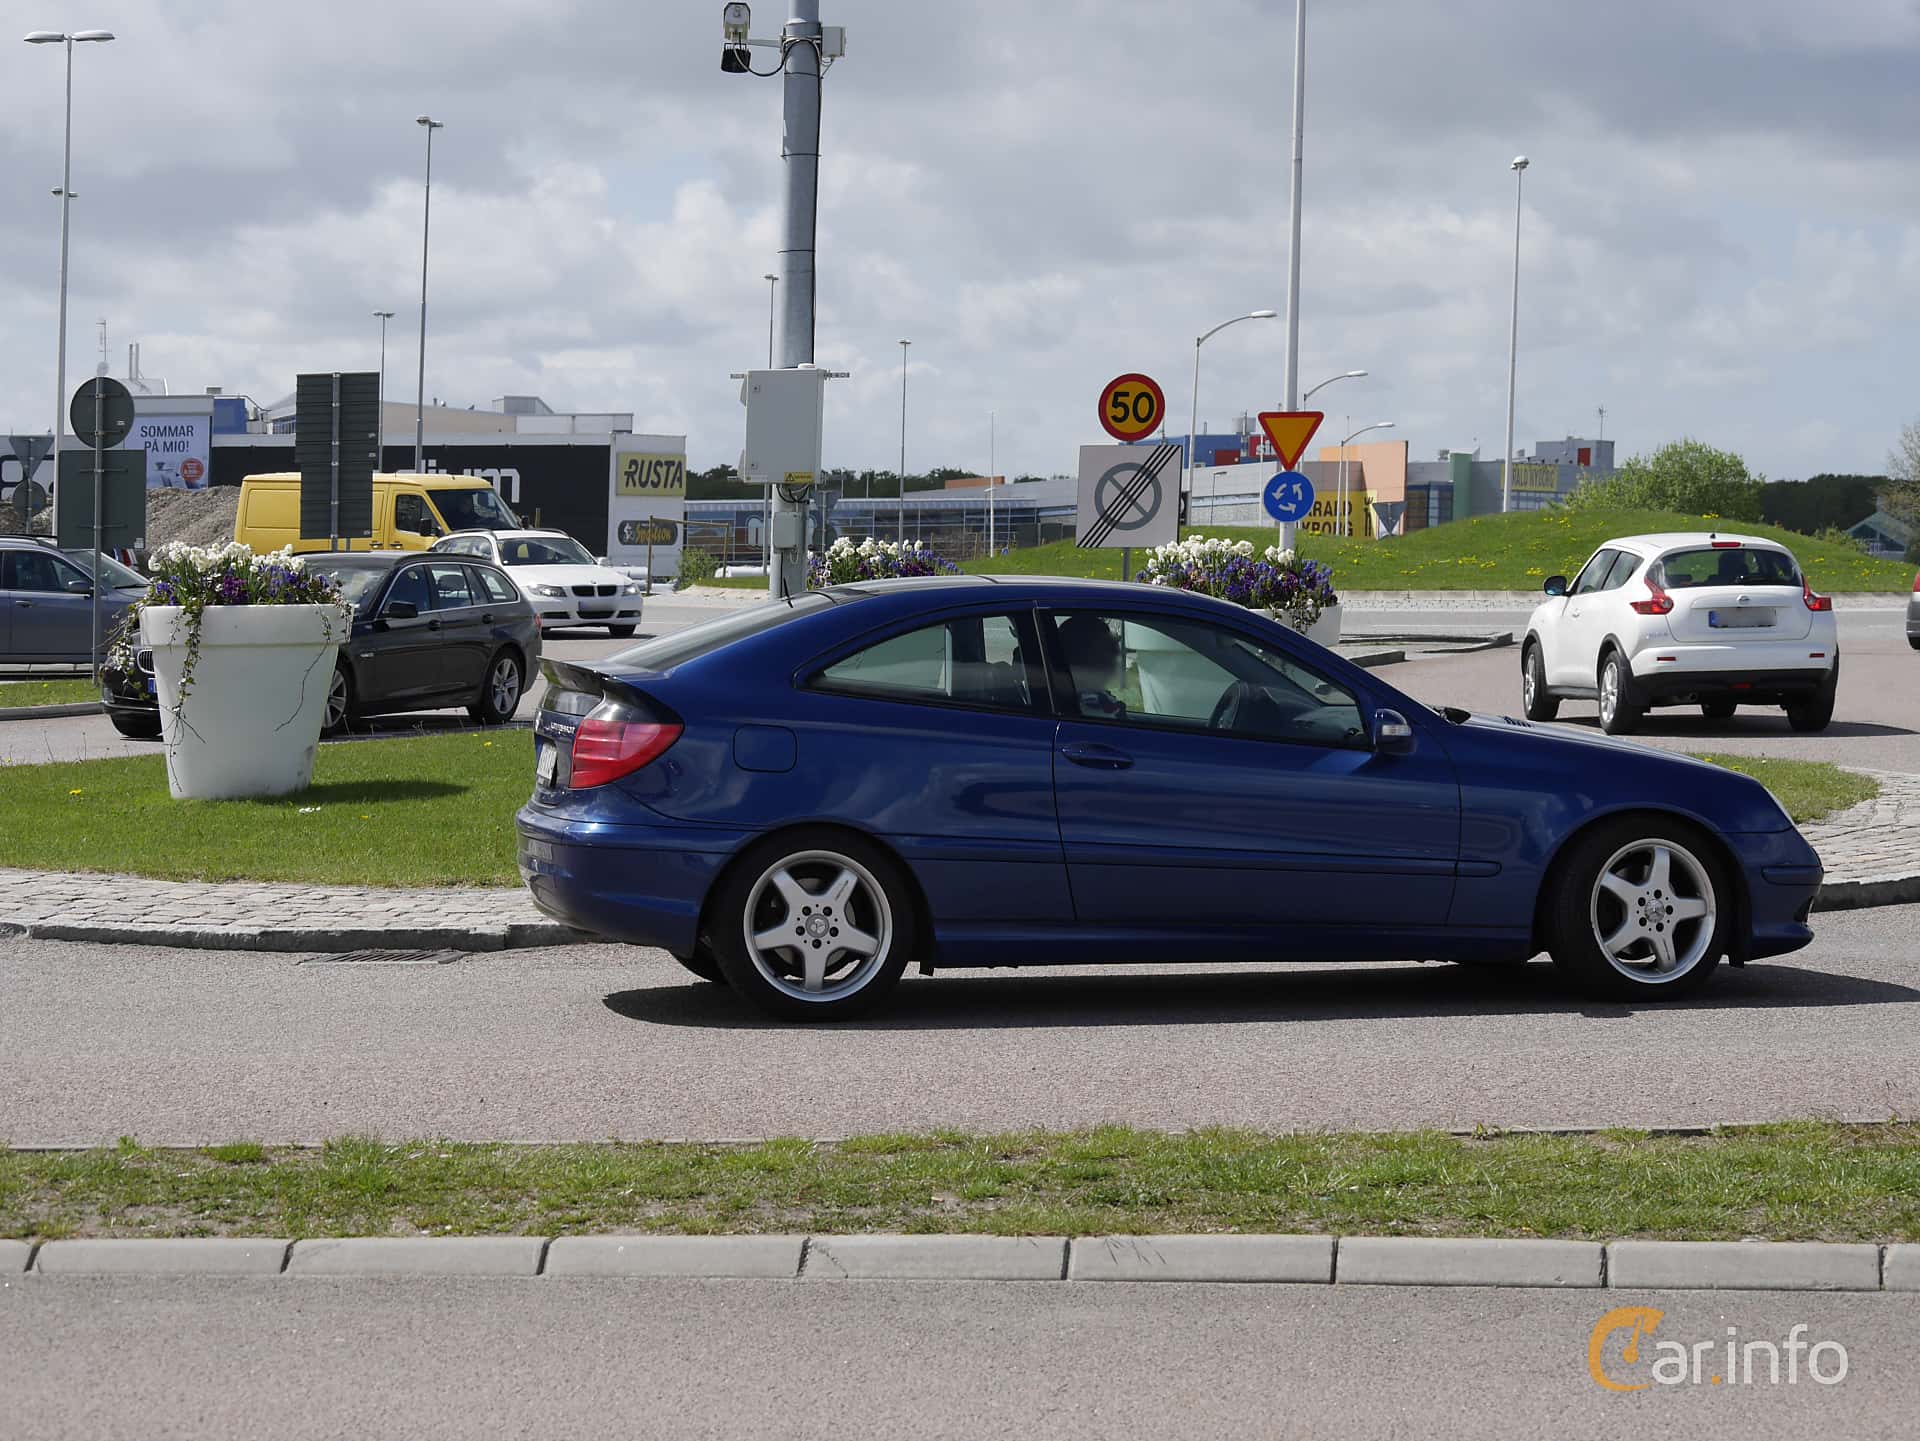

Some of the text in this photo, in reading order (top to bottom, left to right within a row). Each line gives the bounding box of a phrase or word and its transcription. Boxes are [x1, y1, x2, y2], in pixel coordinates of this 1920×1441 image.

[1110, 392, 1156, 424] 50
[140, 425, 194, 438] SOMMAR
[144, 439, 189, 453] PÅ MIO!
[624, 459, 683, 488] RUSTA
[1308, 501, 1353, 517] RALD
